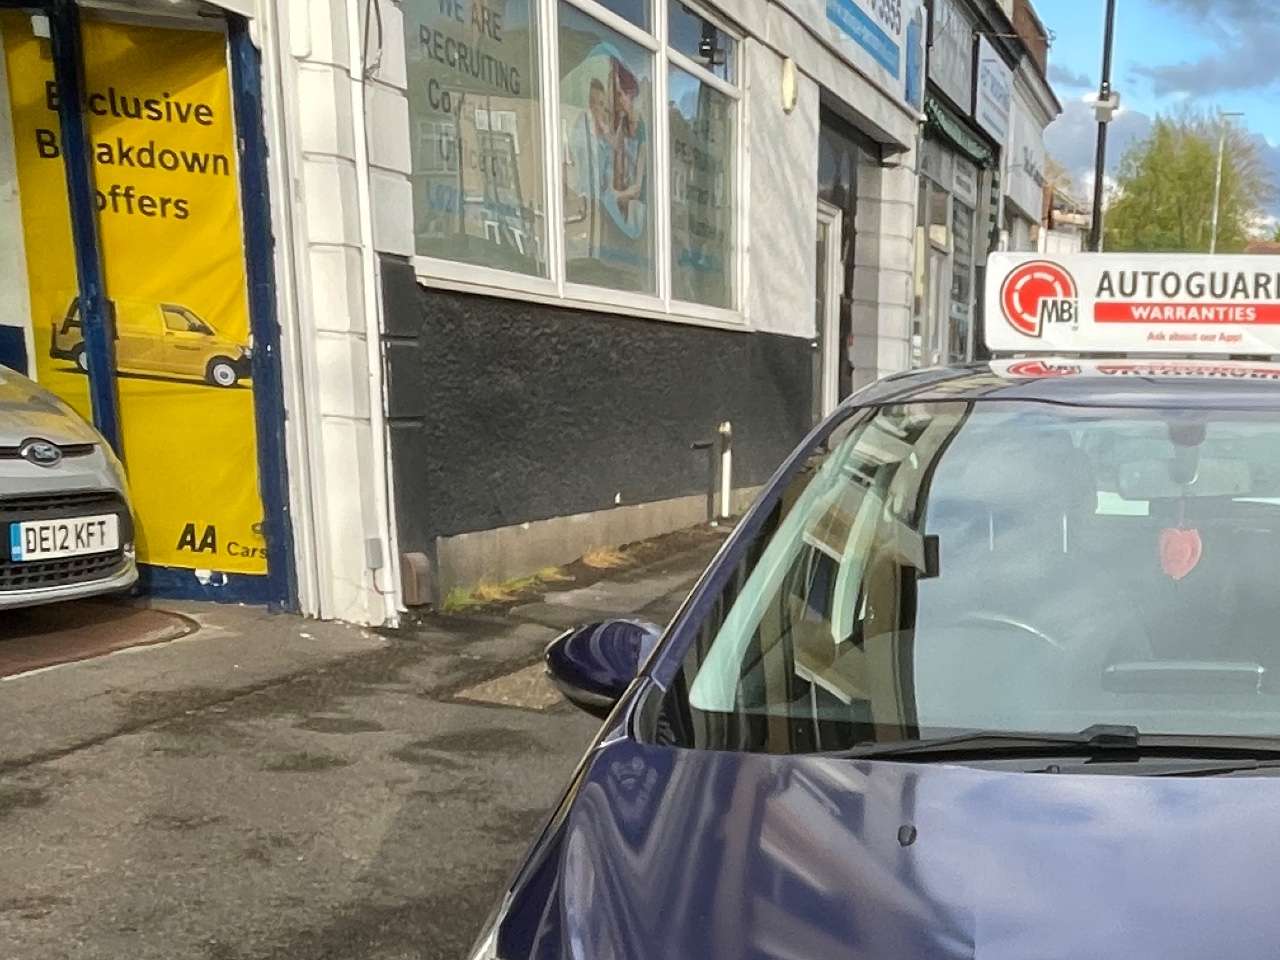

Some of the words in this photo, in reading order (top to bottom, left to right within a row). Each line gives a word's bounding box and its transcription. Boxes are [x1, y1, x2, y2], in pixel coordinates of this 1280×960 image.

[471, 3, 502, 42] ARE
[419, 24, 521, 95] RECRUITING
[45, 81, 213, 126] Eclusive
[36, 129, 229, 176] Bakdown
[1131, 306, 1257, 321] WARRANTIES
[1147, 331, 1165, 342] Ask
[1169, 331, 1197, 342] about
[1200, 333, 1216, 342] our
[25, 523, 70, 554] DE12
[74, 520, 107, 549] KFT
[176, 523, 216, 555] AA
[227, 541, 267, 559] Cars
